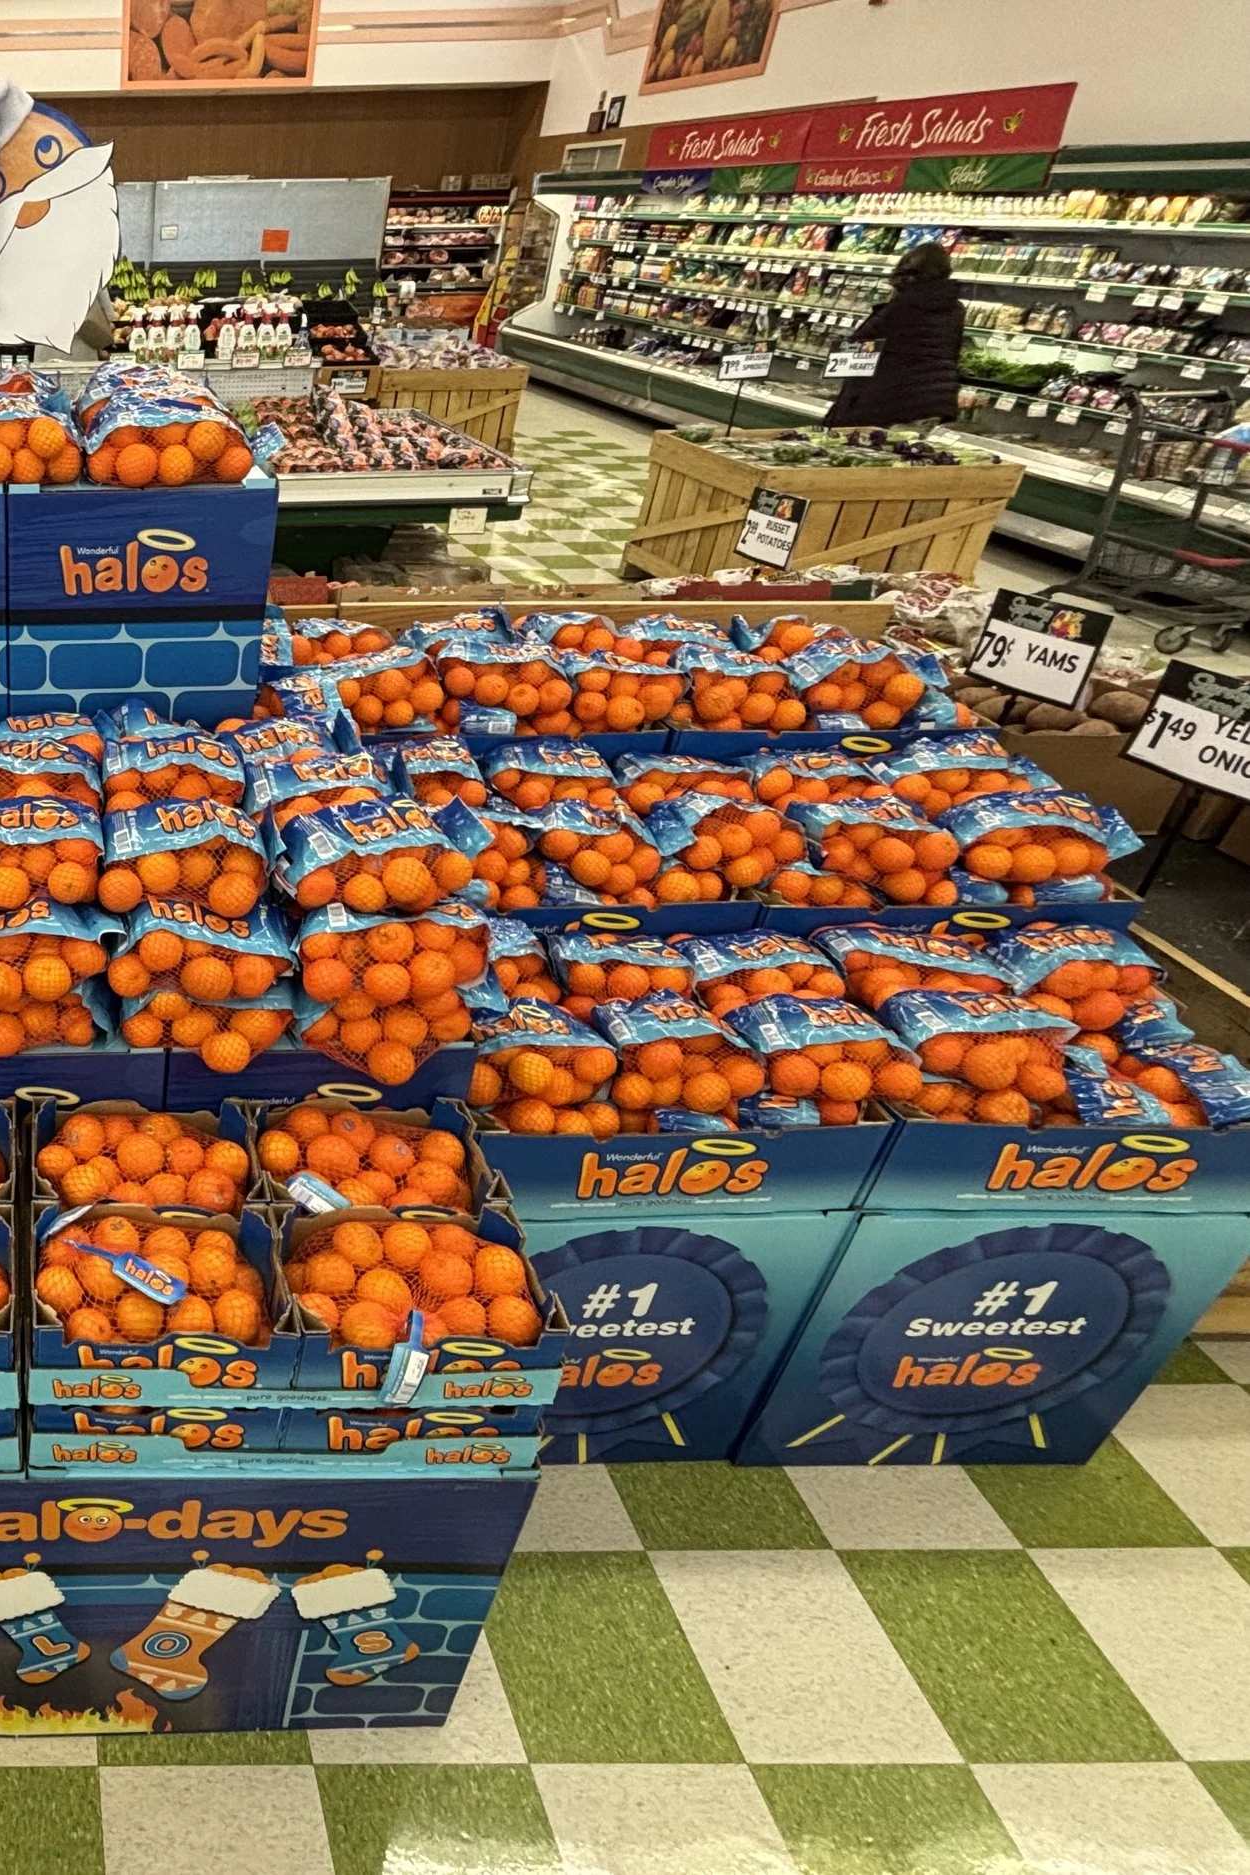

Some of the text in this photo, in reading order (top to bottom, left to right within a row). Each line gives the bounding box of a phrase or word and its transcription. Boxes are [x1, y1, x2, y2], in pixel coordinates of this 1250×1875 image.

[855, 105, 993, 150] Fresh Salads
[679, 127, 764, 161] Fresh Salads
[756, 532, 793, 552] POTATOES
[765, 519, 791, 536] RUSSET
[77, 546, 120, 555] Wonderful
[60, 541, 208, 596] halos
[1025, 642, 1081, 674] YAMS
[146, 738, 239, 767] halos
[148, 898, 251, 939] halos
[870, 928, 974, 962] halos
[606, 1152, 664, 1162] Wonderful
[1027, 1144, 1089, 1154] Wonderful
[577, 1147, 770, 1199] halos
[986, 1142, 1199, 1191] halos
[124, 1257, 175, 1298] halos
[582, 1282, 659, 1319] #1
[972, 1281, 1058, 1317] #1
[905, 1317, 1088, 1337] Sweetest
[560, 1353, 664, 1388] alos
[892, 1352, 1043, 1389] halos
[52, 1377, 142, 1400] halos
[246, 1393, 273, 1403] pure
[276, 1393, 327, 1403] goodness
[443, 1379, 534, 1400] halos
[52, 1444, 138, 1464] halos
[426, 1444, 512, 1465] halos
